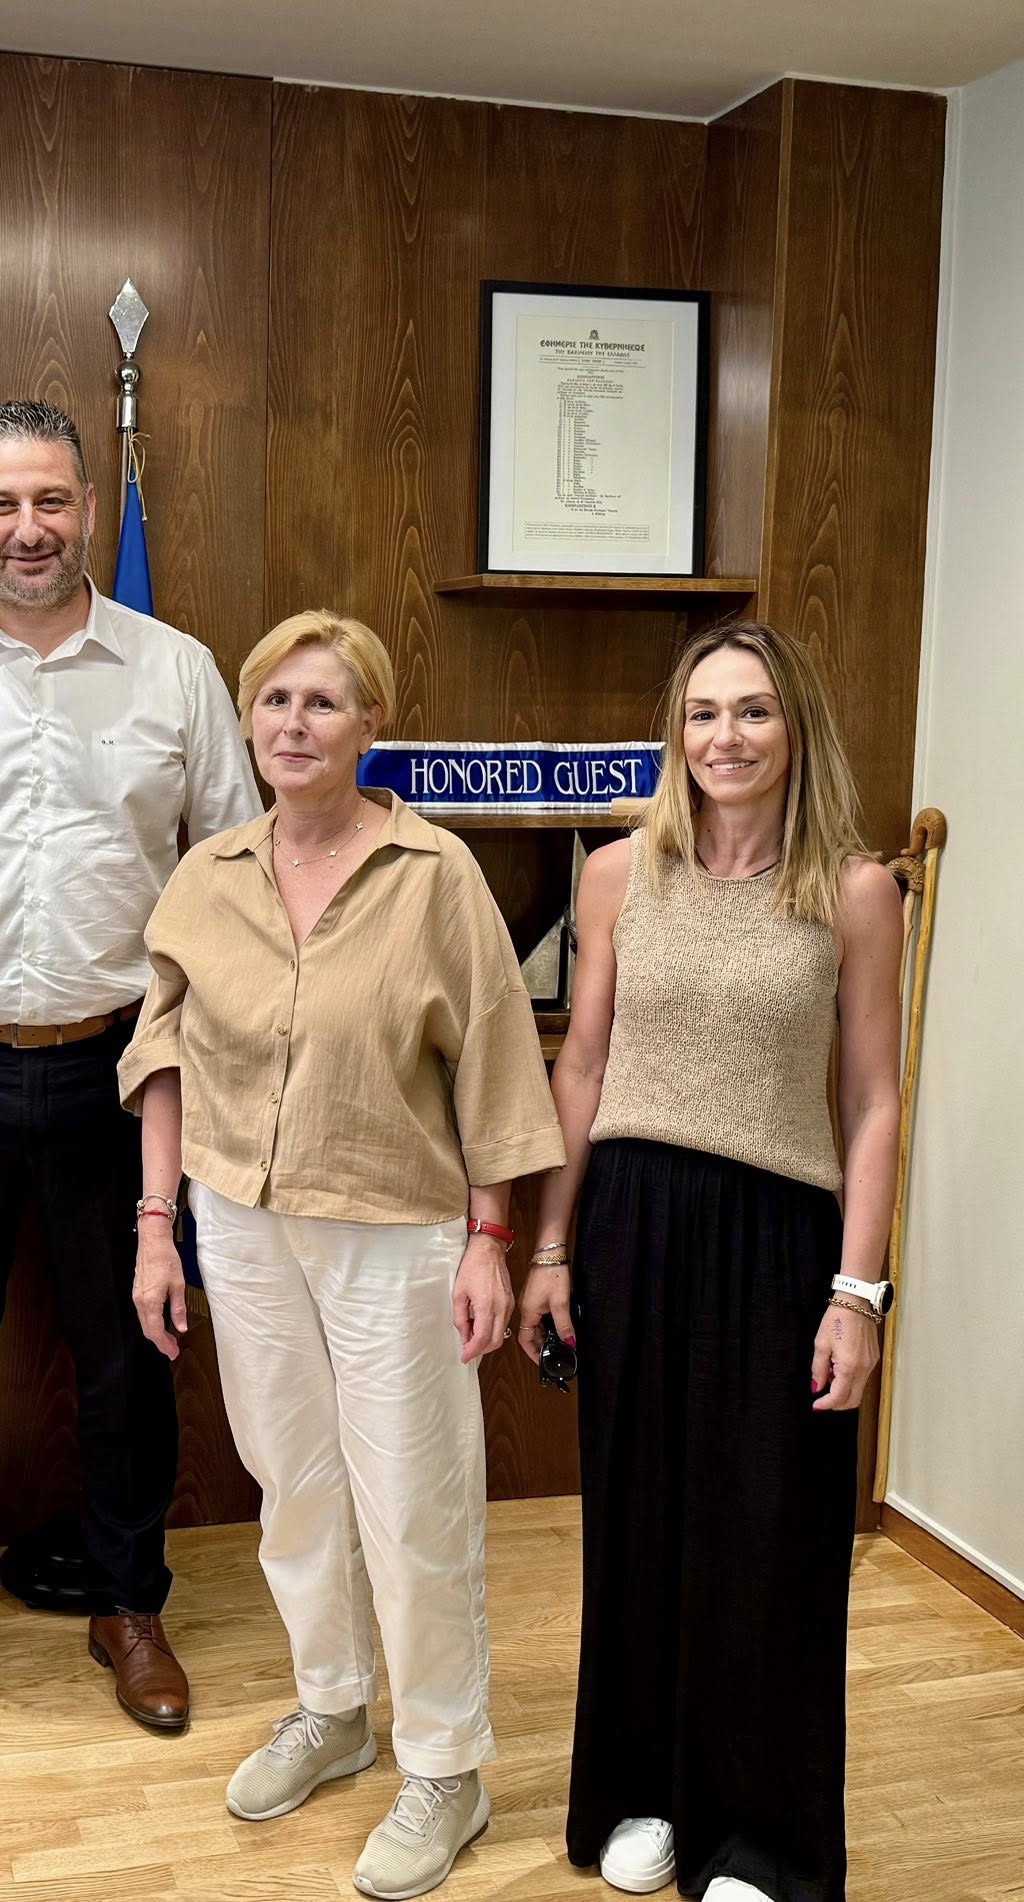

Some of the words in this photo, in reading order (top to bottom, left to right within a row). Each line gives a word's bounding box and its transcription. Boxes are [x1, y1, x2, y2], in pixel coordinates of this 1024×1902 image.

[579, 341, 593, 350] ΤΗΣ
[410, 758, 542, 795] HONORED
[554, 759, 642, 796] GUEST
